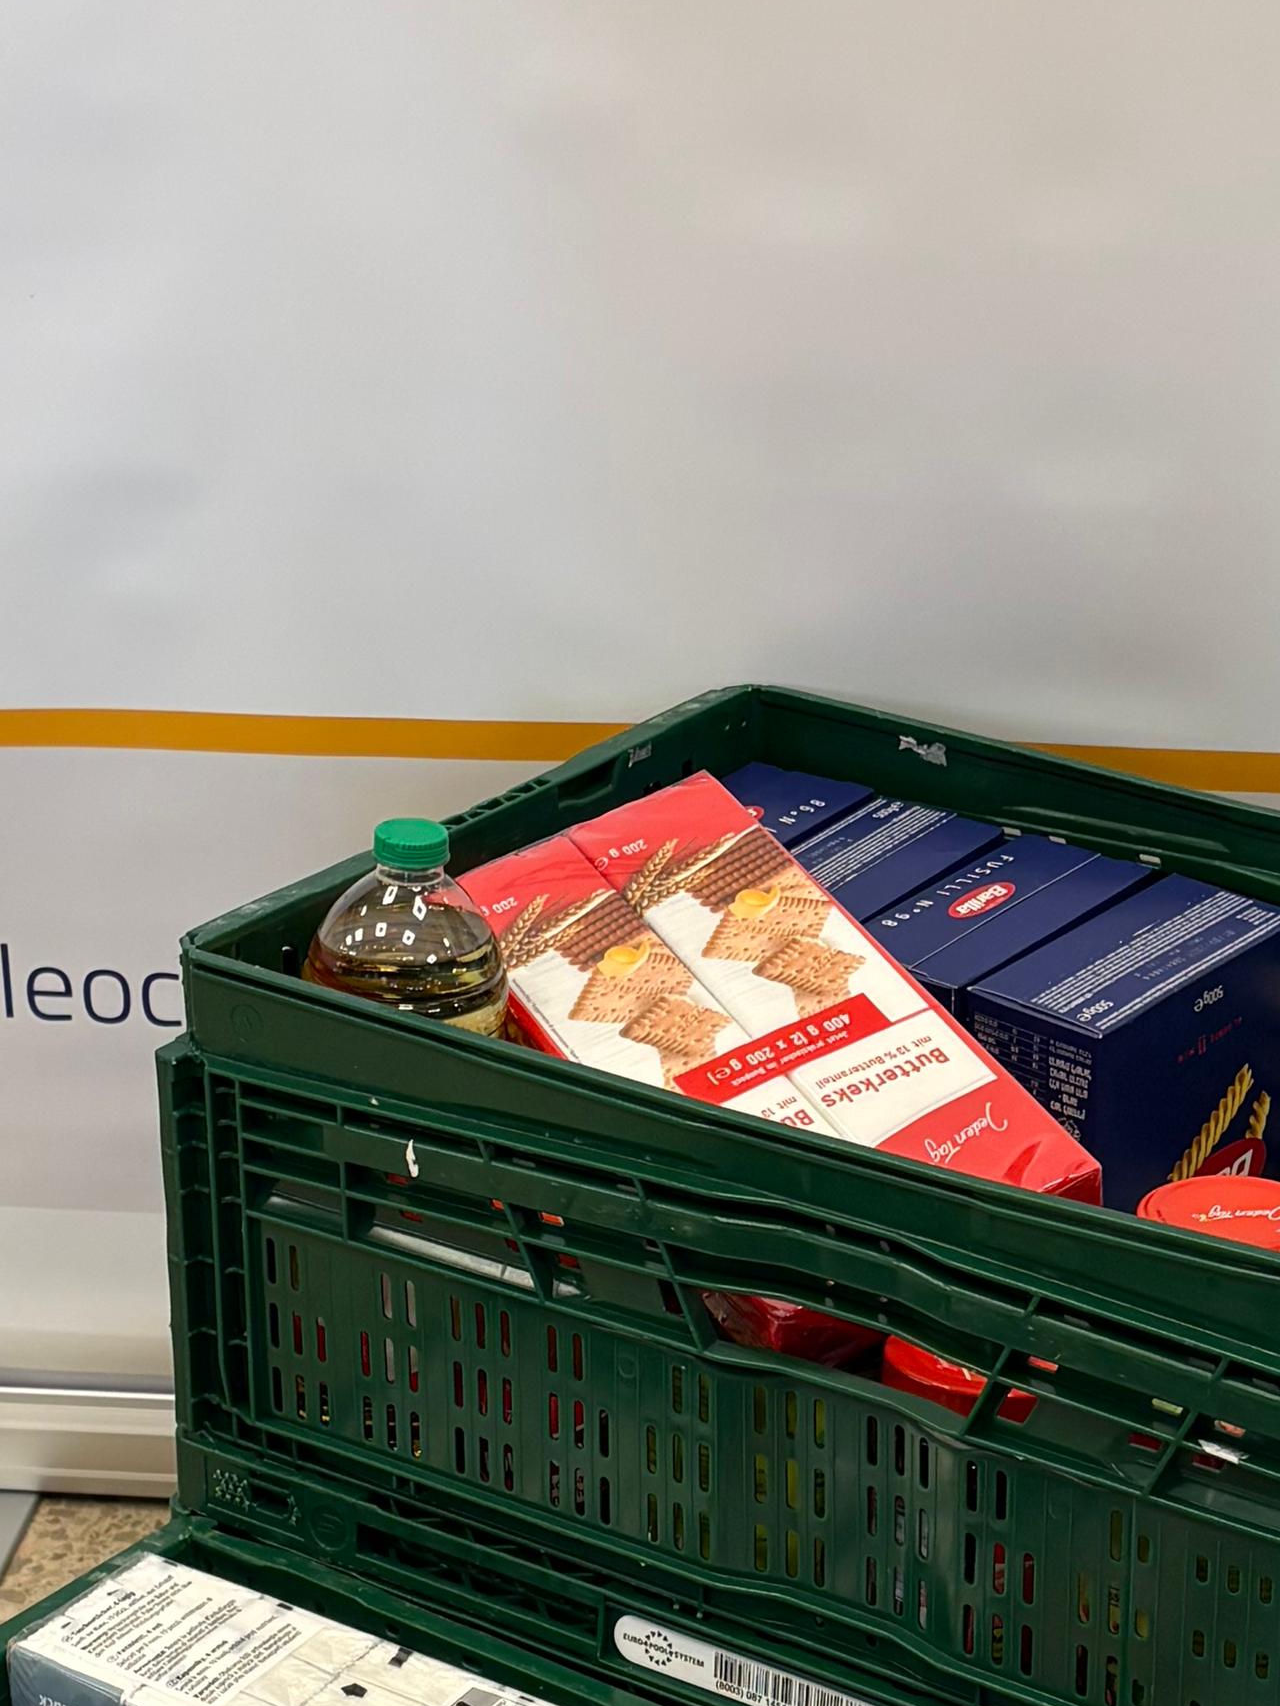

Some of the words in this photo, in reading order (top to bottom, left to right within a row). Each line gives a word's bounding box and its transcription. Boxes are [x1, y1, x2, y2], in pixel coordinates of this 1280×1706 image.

[621, 837, 648, 859] 200
[937, 853, 1015, 896] FUSILLI
[492, 895, 518, 915] 200
[952, 882, 1013, 917] Barilla
[820, 1011, 852, 1033] 400
[911, 1033, 933, 1050] mit
[744, 1044, 774, 1067] 200
[813, 1053, 886, 1091] Butteranteil
[817, 1044, 952, 1113] Butterkeks
[746, 1691, 764, 1704] 087
